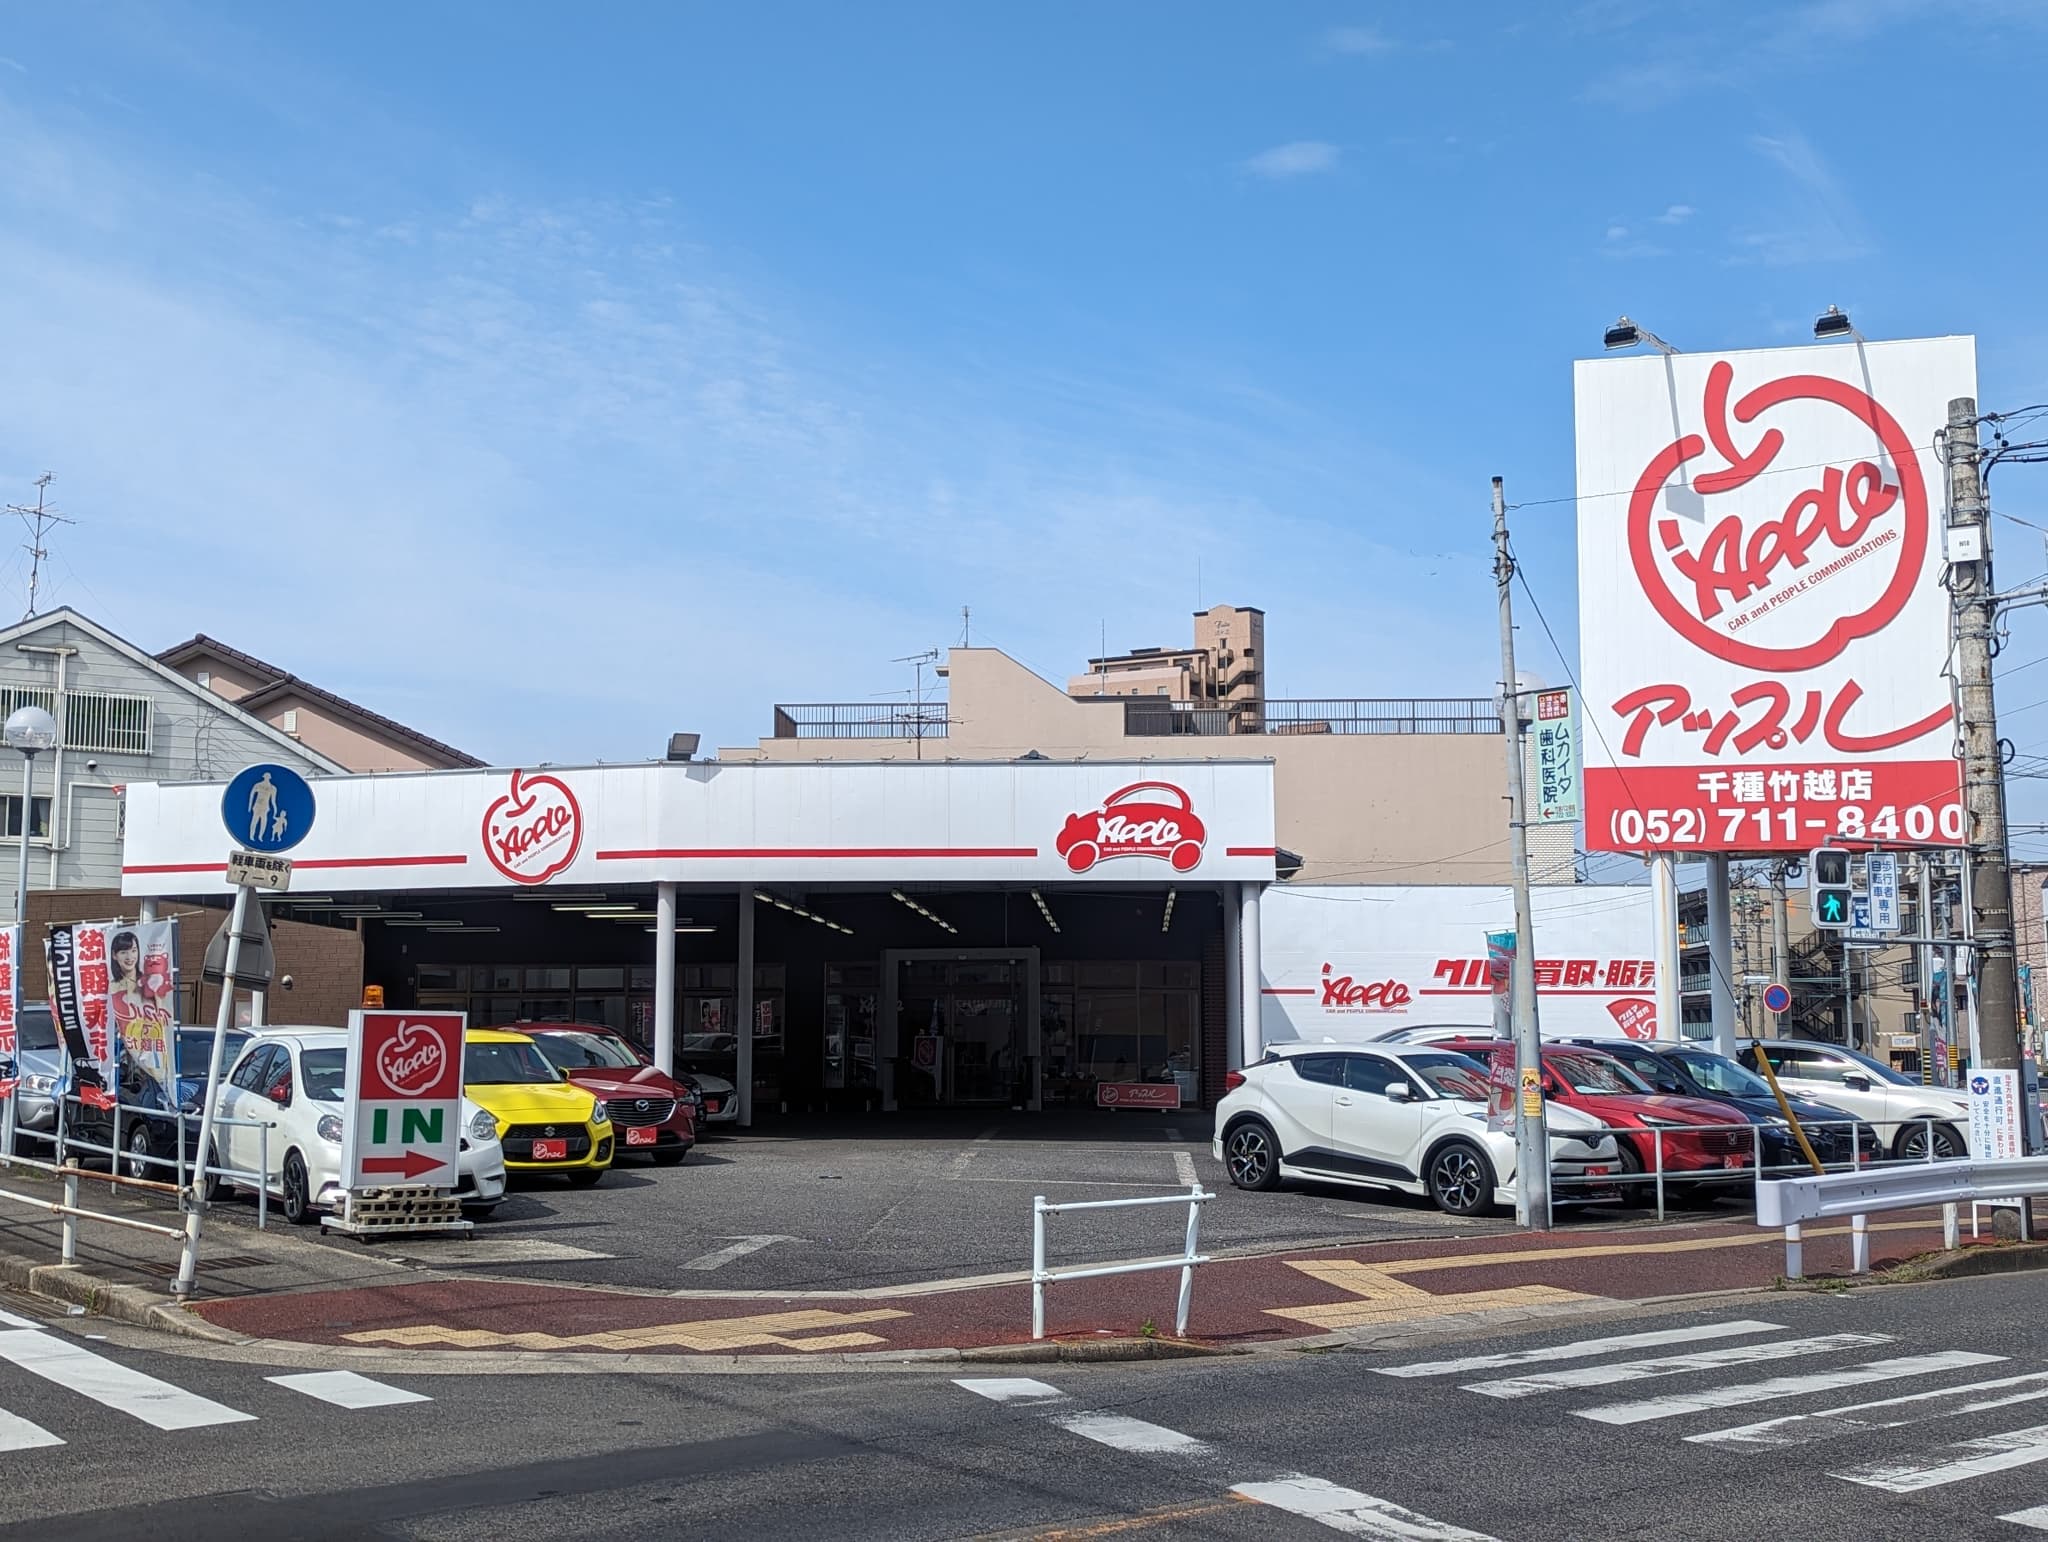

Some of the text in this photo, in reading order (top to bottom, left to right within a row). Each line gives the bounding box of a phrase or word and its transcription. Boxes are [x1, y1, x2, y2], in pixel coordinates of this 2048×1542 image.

[1659, 462, 1899, 622] Apple
[1728, 529, 1897, 631] CAR and PEOPLE COMMUNICATIONS
[1612, 679, 1954, 757] アップル
[1540, 729, 1558, 803] 歯科医院
[1555, 722, 1572, 794] ムカイダ
[1697, 769, 1873, 803] 千種竹越店
[492, 805, 572, 864] Apple
[1096, 815, 1182, 845] Apple
[1610, 803, 1967, 845] (052) 711-8400
[232, 854, 290, 874] 軽車両を除く
[1872, 861, 1883, 897] 自転車
[1882, 860, 1894, 897] 歩行者
[1879, 899, 1890, 924] 専用
[1322, 963, 1411, 1008] Apple
[385, 1045, 440, 1082] Apple
[372, 1108, 444, 1144] IN
